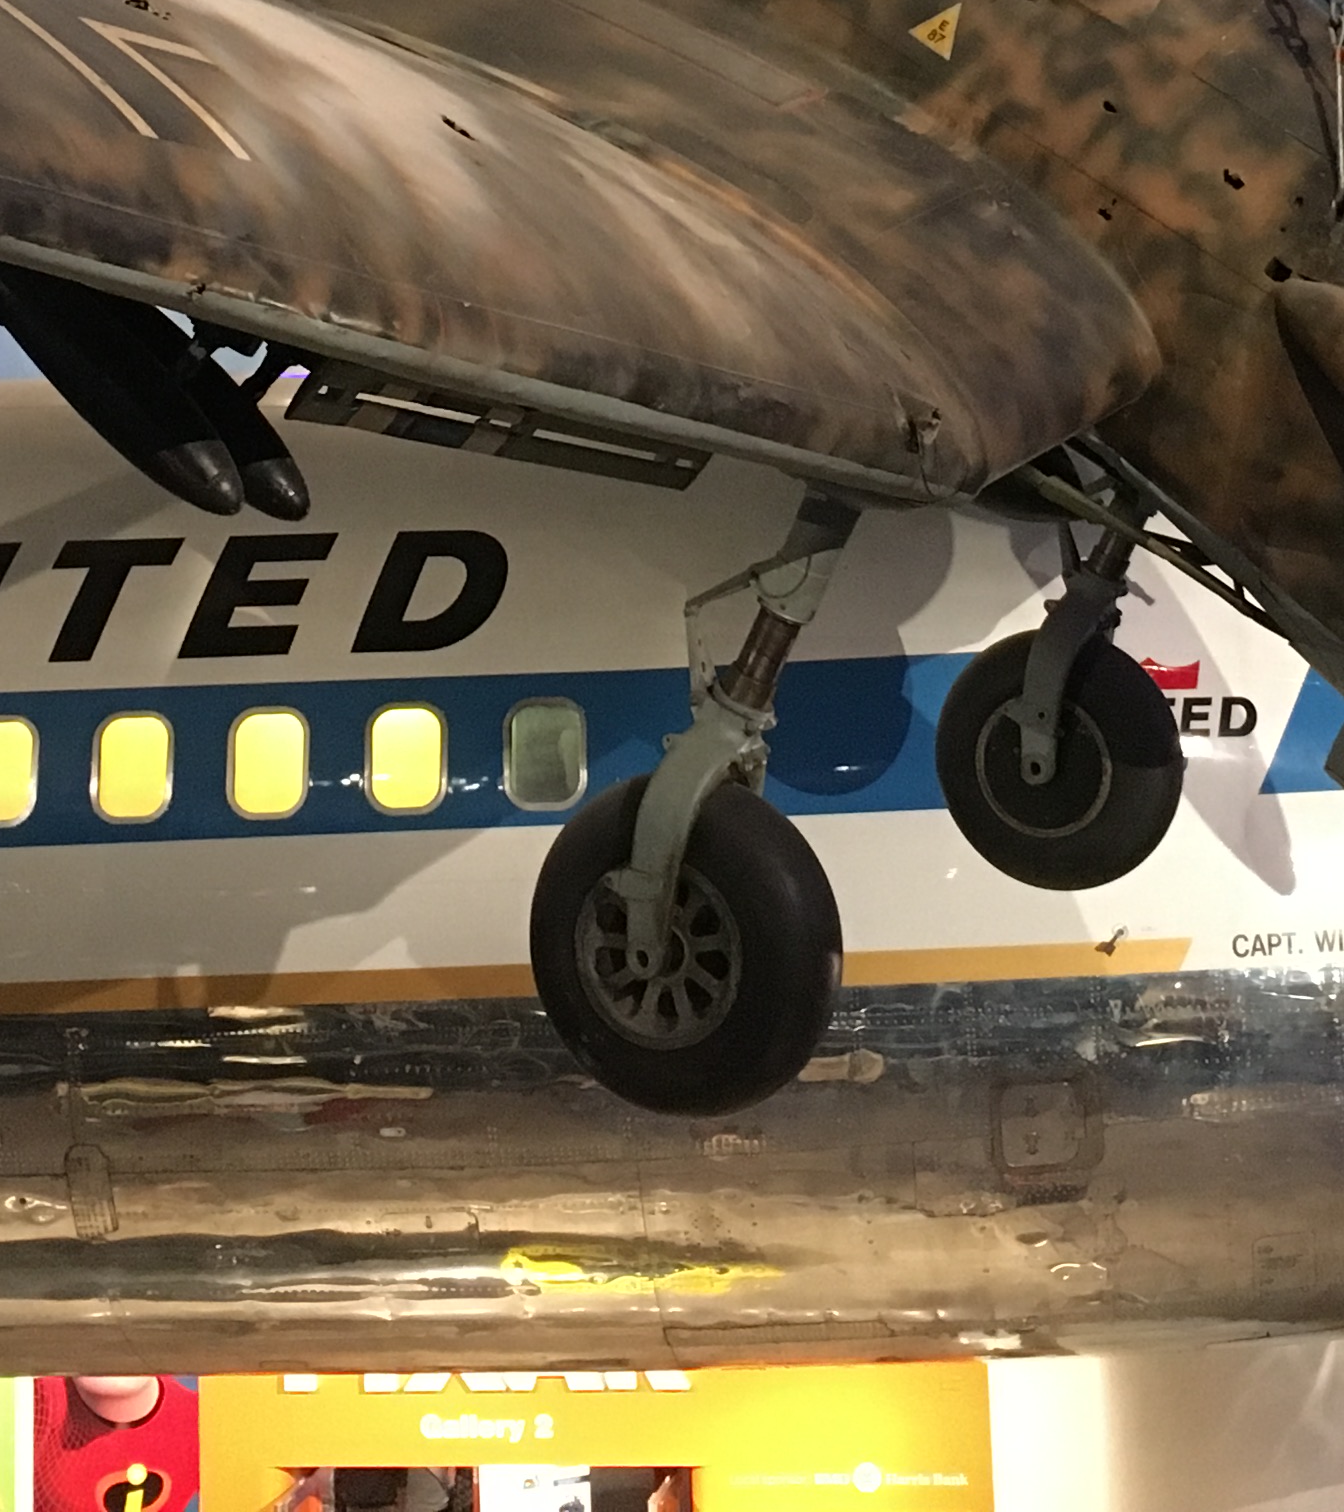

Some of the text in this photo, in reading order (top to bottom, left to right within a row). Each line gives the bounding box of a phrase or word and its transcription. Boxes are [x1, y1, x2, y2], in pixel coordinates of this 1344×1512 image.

[938, 19, 950, 31] E
[926, 29, 946, 43] 87
[1231, 932, 1304, 959] CAPT.
[420, 1413, 554, 1444] Gallery 2
